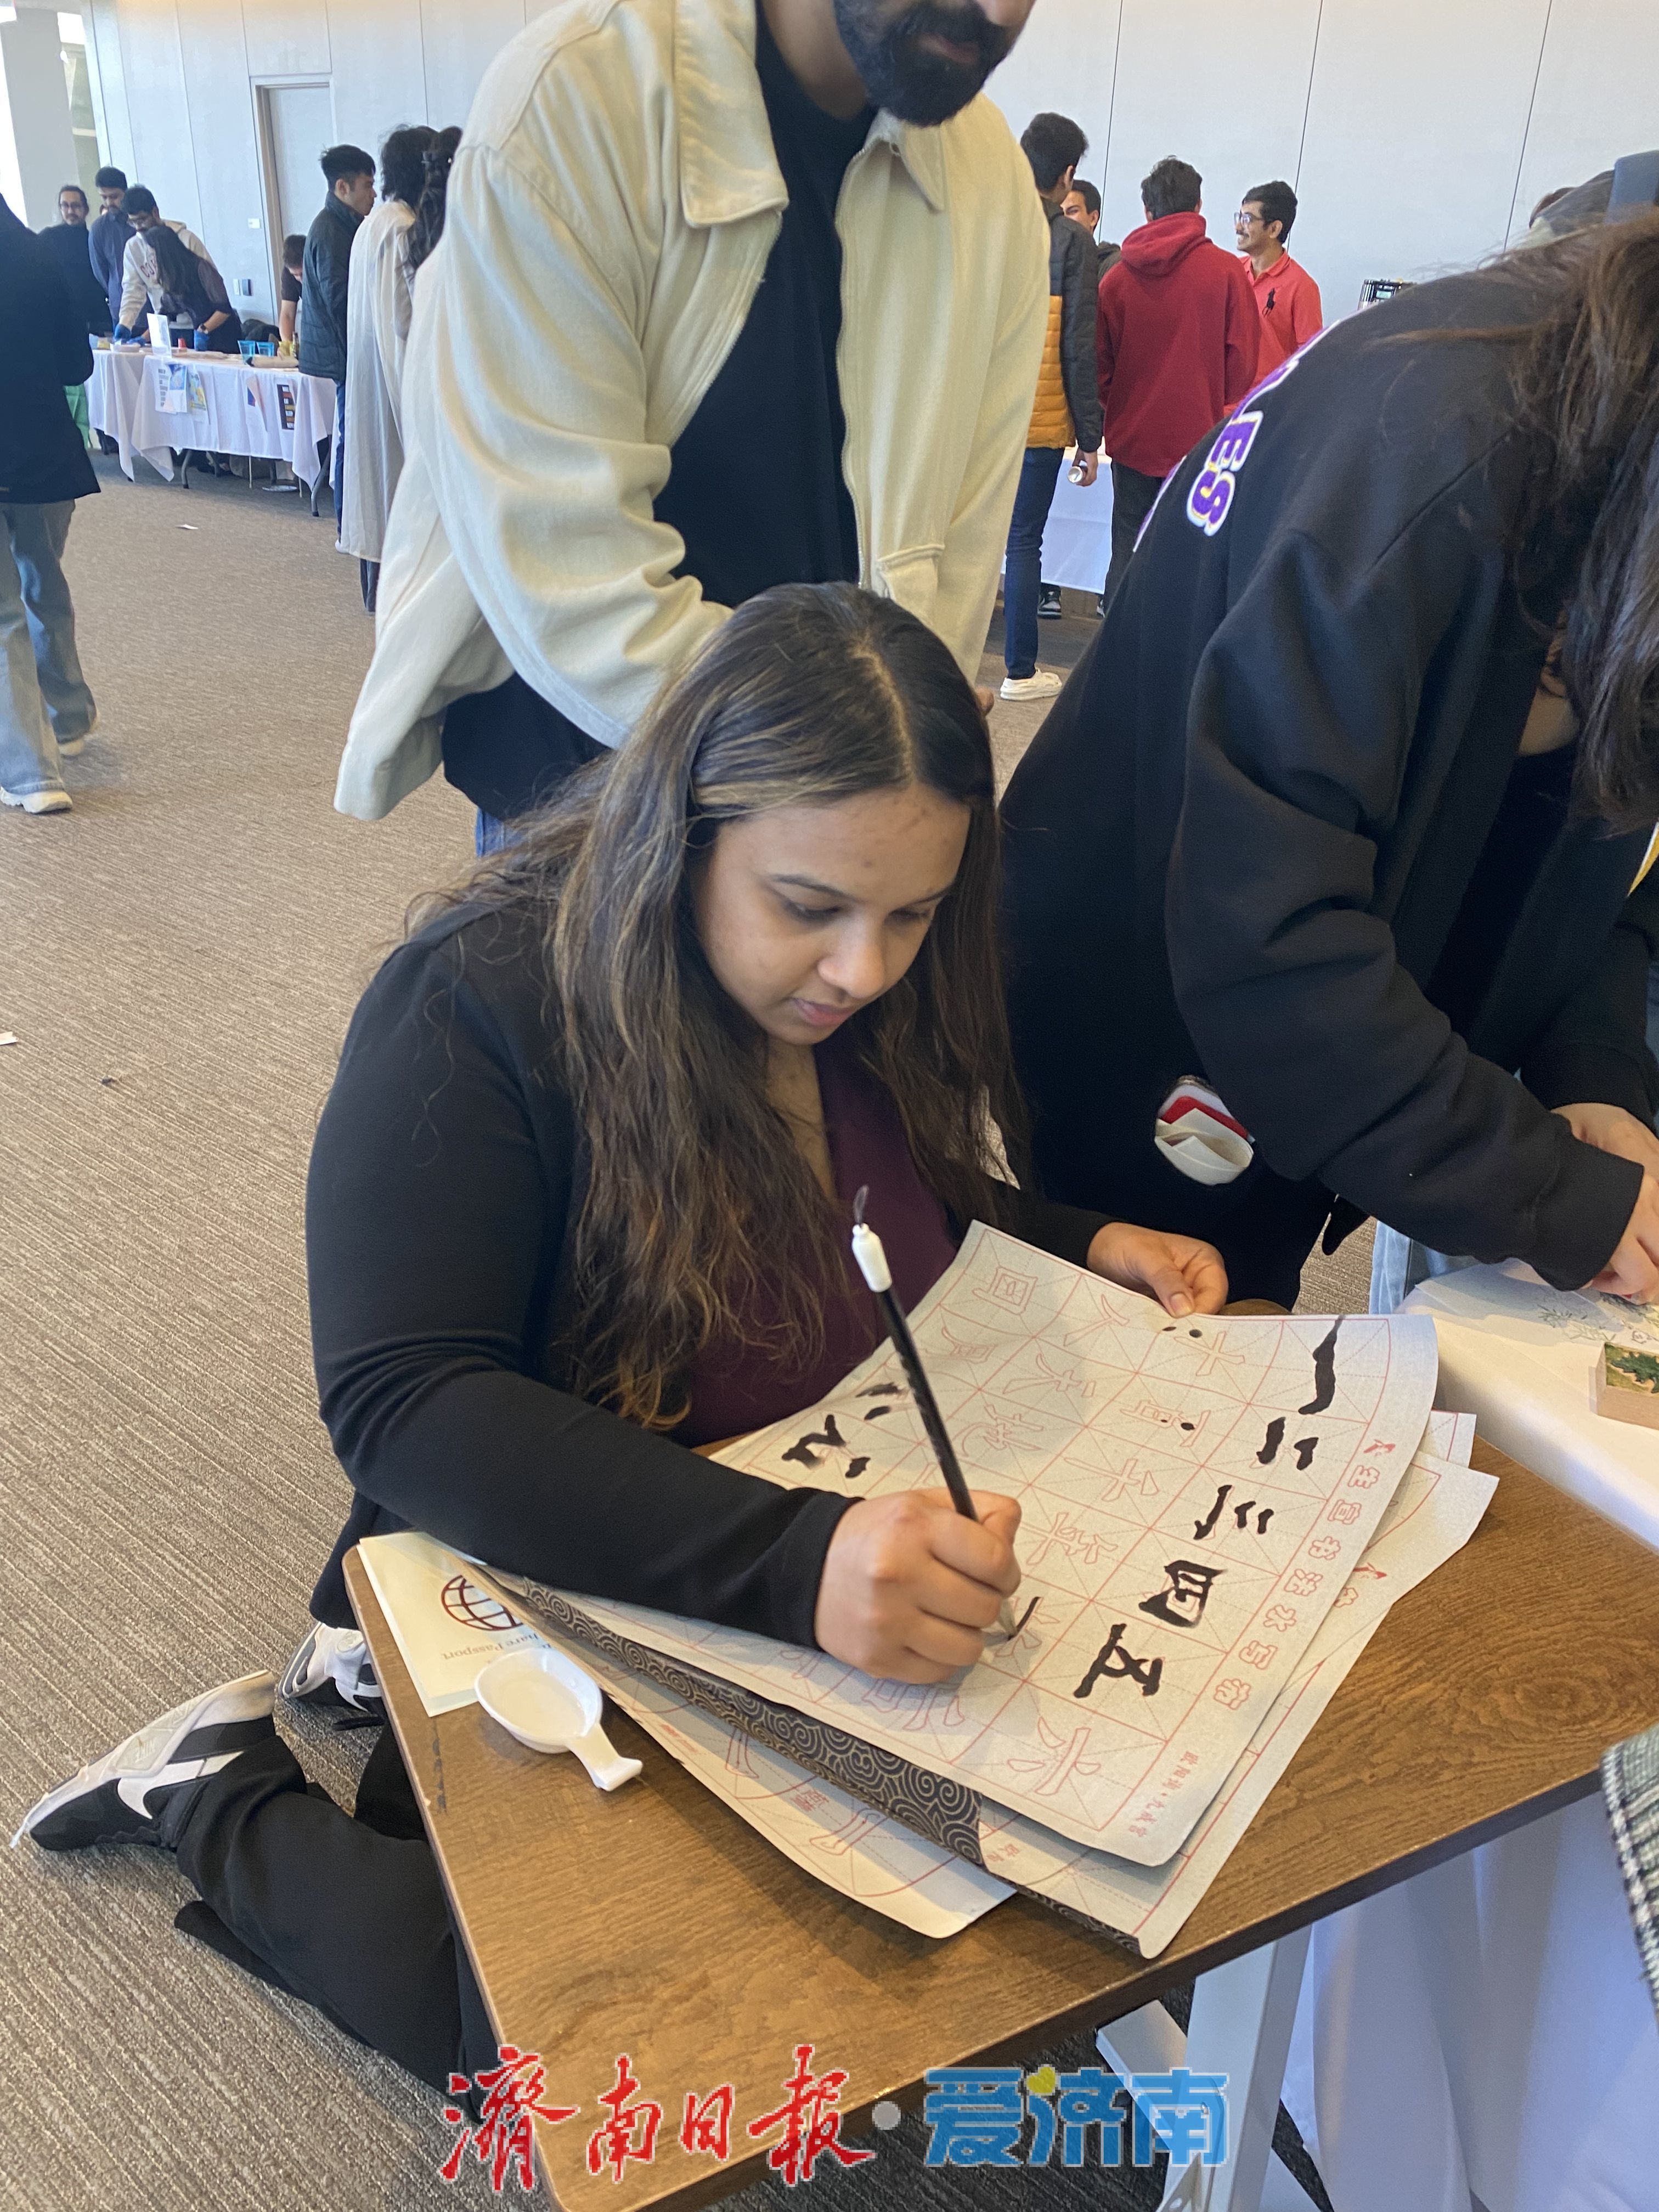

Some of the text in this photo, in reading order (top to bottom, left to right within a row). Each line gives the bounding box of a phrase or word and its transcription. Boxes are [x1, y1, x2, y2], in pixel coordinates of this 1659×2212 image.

[1186, 410, 1264, 537] ES
[506, 1633, 539, 1647] hare
[441, 1643, 504, 1660] Passport
